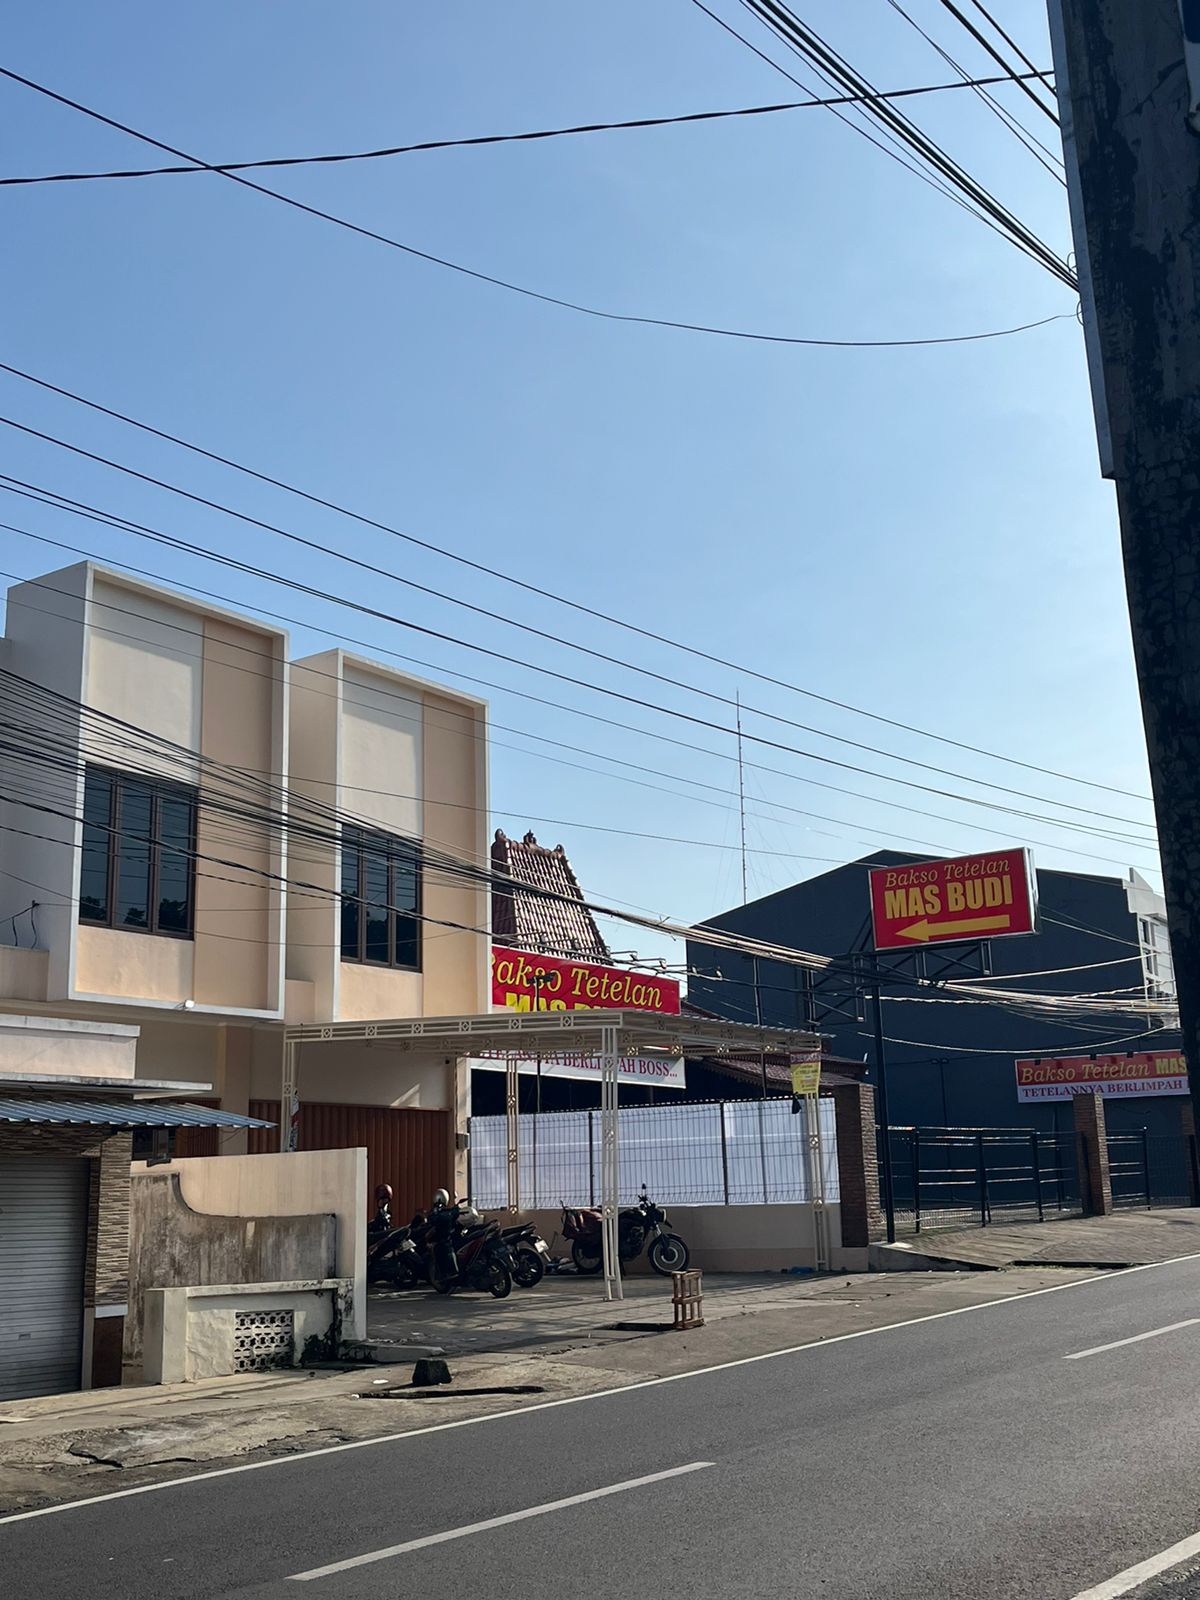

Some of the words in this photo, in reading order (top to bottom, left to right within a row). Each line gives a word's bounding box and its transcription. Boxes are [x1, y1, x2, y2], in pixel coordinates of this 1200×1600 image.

[885, 868, 938, 888] Bakso
[944, 859, 1010, 880] Tetelan
[884, 885, 941, 919] MAS
[947, 875, 1013, 912] BUDI
[491, 953, 561, 992] akso
[571, 968, 662, 1008] Tetelan
[1021, 1066, 1076, 1083] Bakso
[1082, 1061, 1150, 1080] Tetelan
[1108, 1080, 1182, 1093] BERLIMPAH
